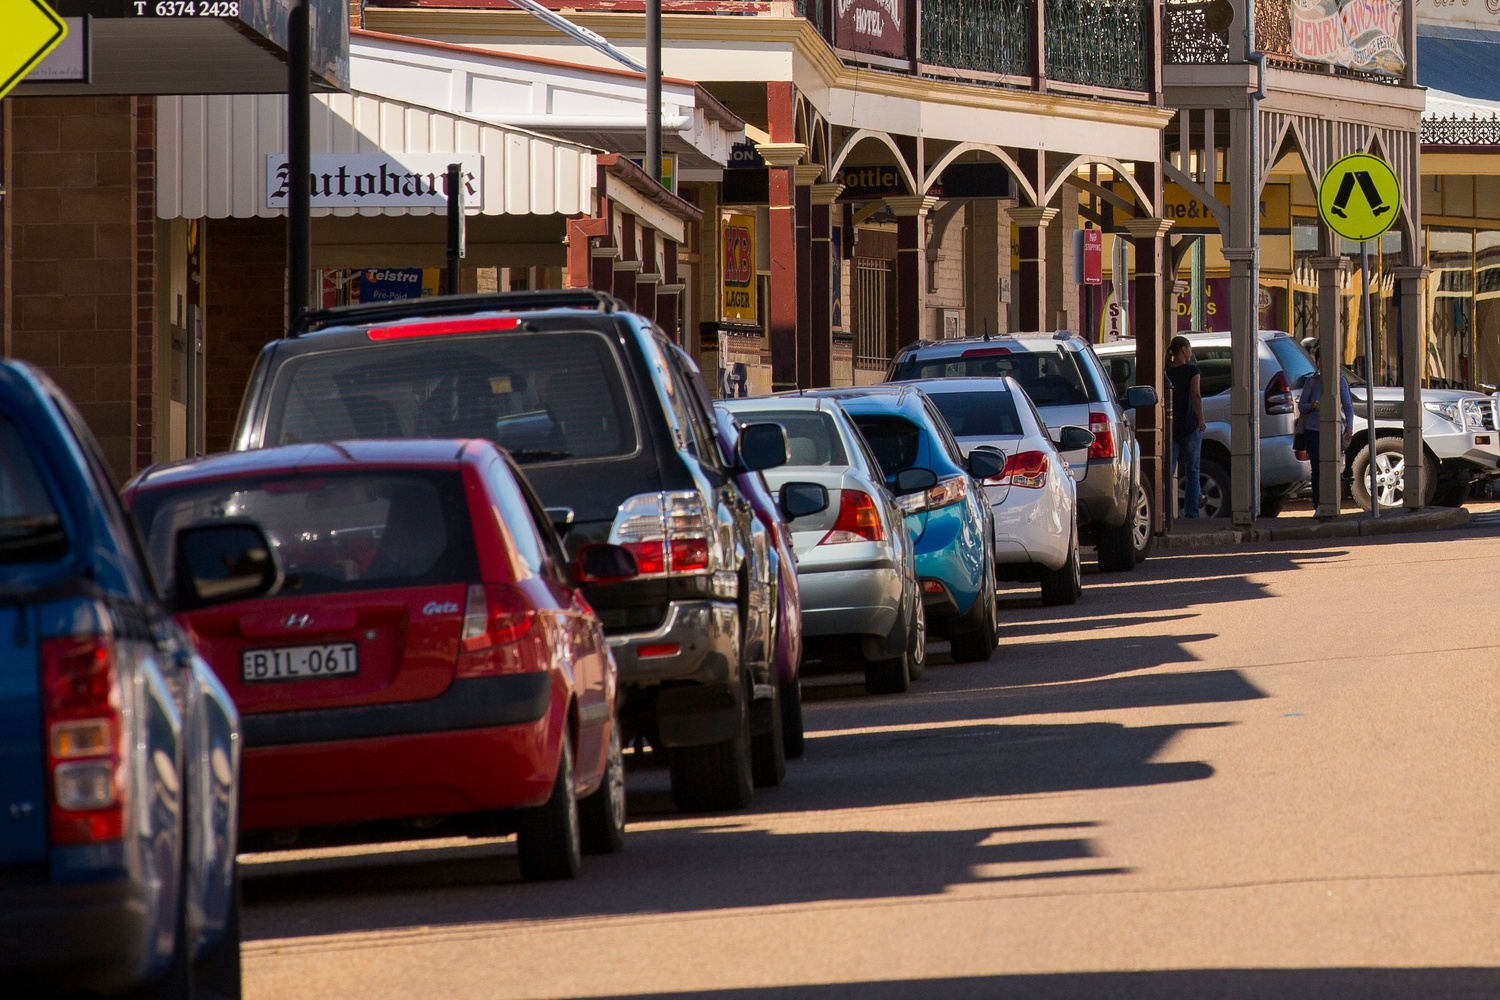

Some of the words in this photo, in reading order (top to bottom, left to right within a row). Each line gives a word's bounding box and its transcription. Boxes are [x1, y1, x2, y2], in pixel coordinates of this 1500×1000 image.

[134, 1, 147, 16] T
[155, 0, 196, 17] 6374
[199, 1, 240, 17] 2428
[856, 7, 882, 37] HOTEL
[1294, 14, 1338, 57] HENRY
[724, 226, 750, 286] KB
[367, 269, 419, 283] Telstra
[373, 290, 408, 301] Pre-Paid
[726, 291, 750, 309] LAGER
